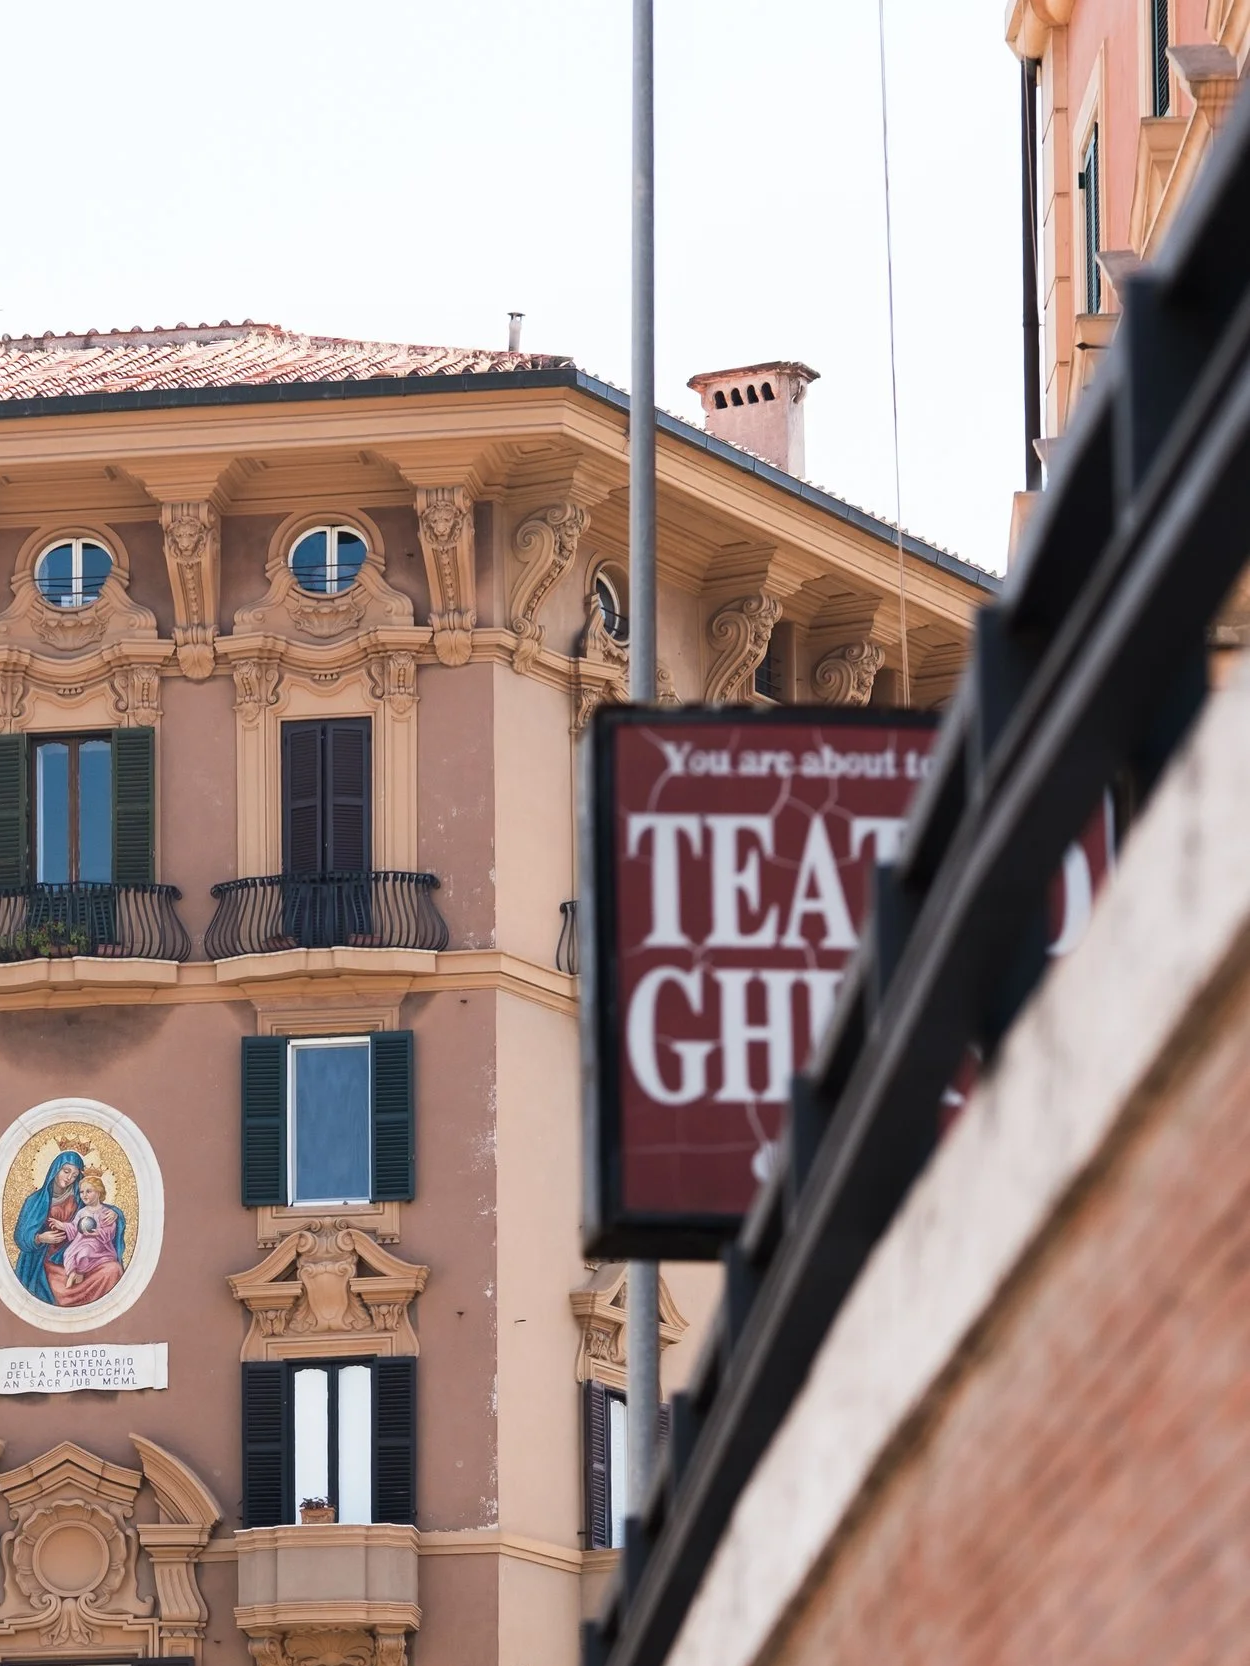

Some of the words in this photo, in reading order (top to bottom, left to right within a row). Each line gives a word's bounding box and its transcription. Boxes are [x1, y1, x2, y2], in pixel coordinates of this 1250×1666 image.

[663, 740, 731, 776] You
[739, 749, 794, 776] are
[801, 743, 897, 778] about
[39, 1351, 46, 1359] A
[54, 1349, 106, 1359] RICORDO
[10, 1361, 33, 1370] DEL
[54, 1357, 134, 1368] CENTENARIO
[6, 1370, 46, 1379] DELLA
[56, 1367, 135, 1378] PARROCCHIA
[3, 1380, 20, 1388] AN
[30, 1379, 61, 1387] SACR
[70, 1378, 91, 1388] JUB
[102, 1377, 138, 1386] MCML
